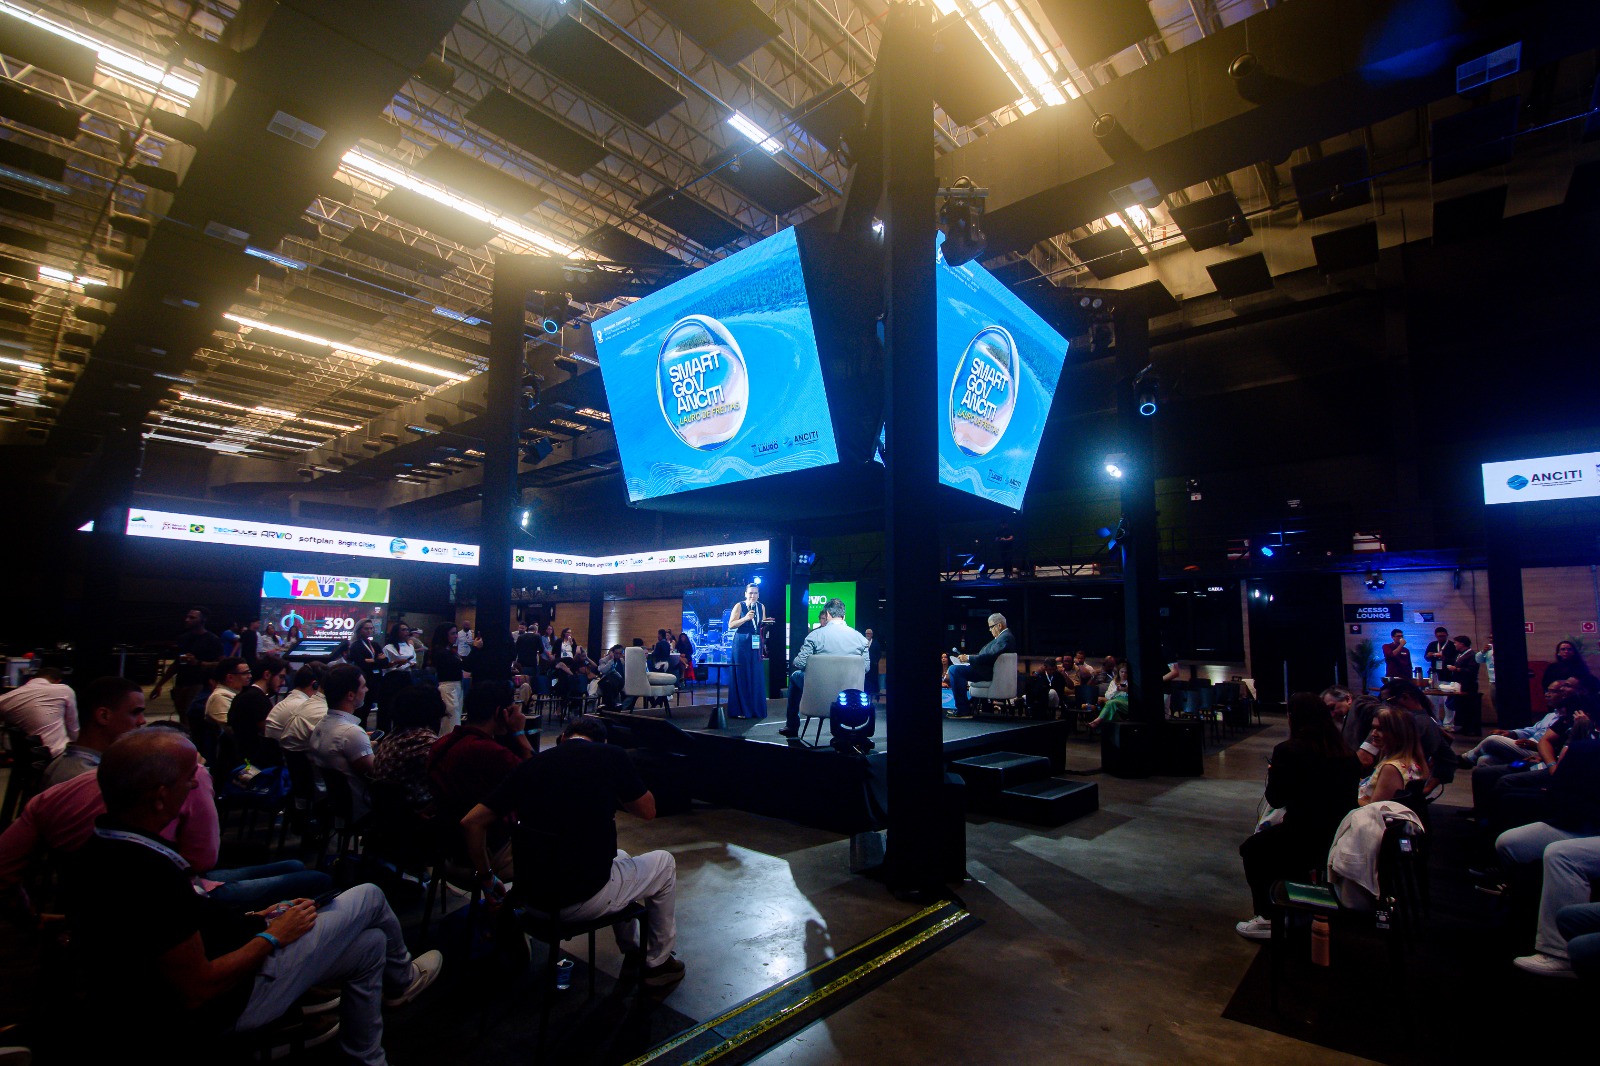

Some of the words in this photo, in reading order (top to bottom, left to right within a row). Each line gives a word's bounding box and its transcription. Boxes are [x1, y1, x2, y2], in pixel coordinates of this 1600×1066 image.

[669, 350, 721, 382] SMART
[971, 358, 1009, 391] SMART
[673, 373, 704, 398] GOV
[967, 374, 993, 399] GOV
[677, 385, 725, 414] ANCITI
[961, 390, 997, 421] ANCITI
[680, 413, 700, 425] LAURO
[702, 410, 710, 419] DE
[712, 402, 741, 416] FREITAS
[758, 443, 779, 453] LAURO
[794, 431, 819, 442] ANCITI
[1531, 469, 1583, 482] ANCITI
[299, 536, 334, 545] softplan
[338, 539, 357, 547] Bright
[291, 579, 361, 599] LAURO
[317, 576, 335, 585] VIVA
[322, 617, 355, 630] 390
